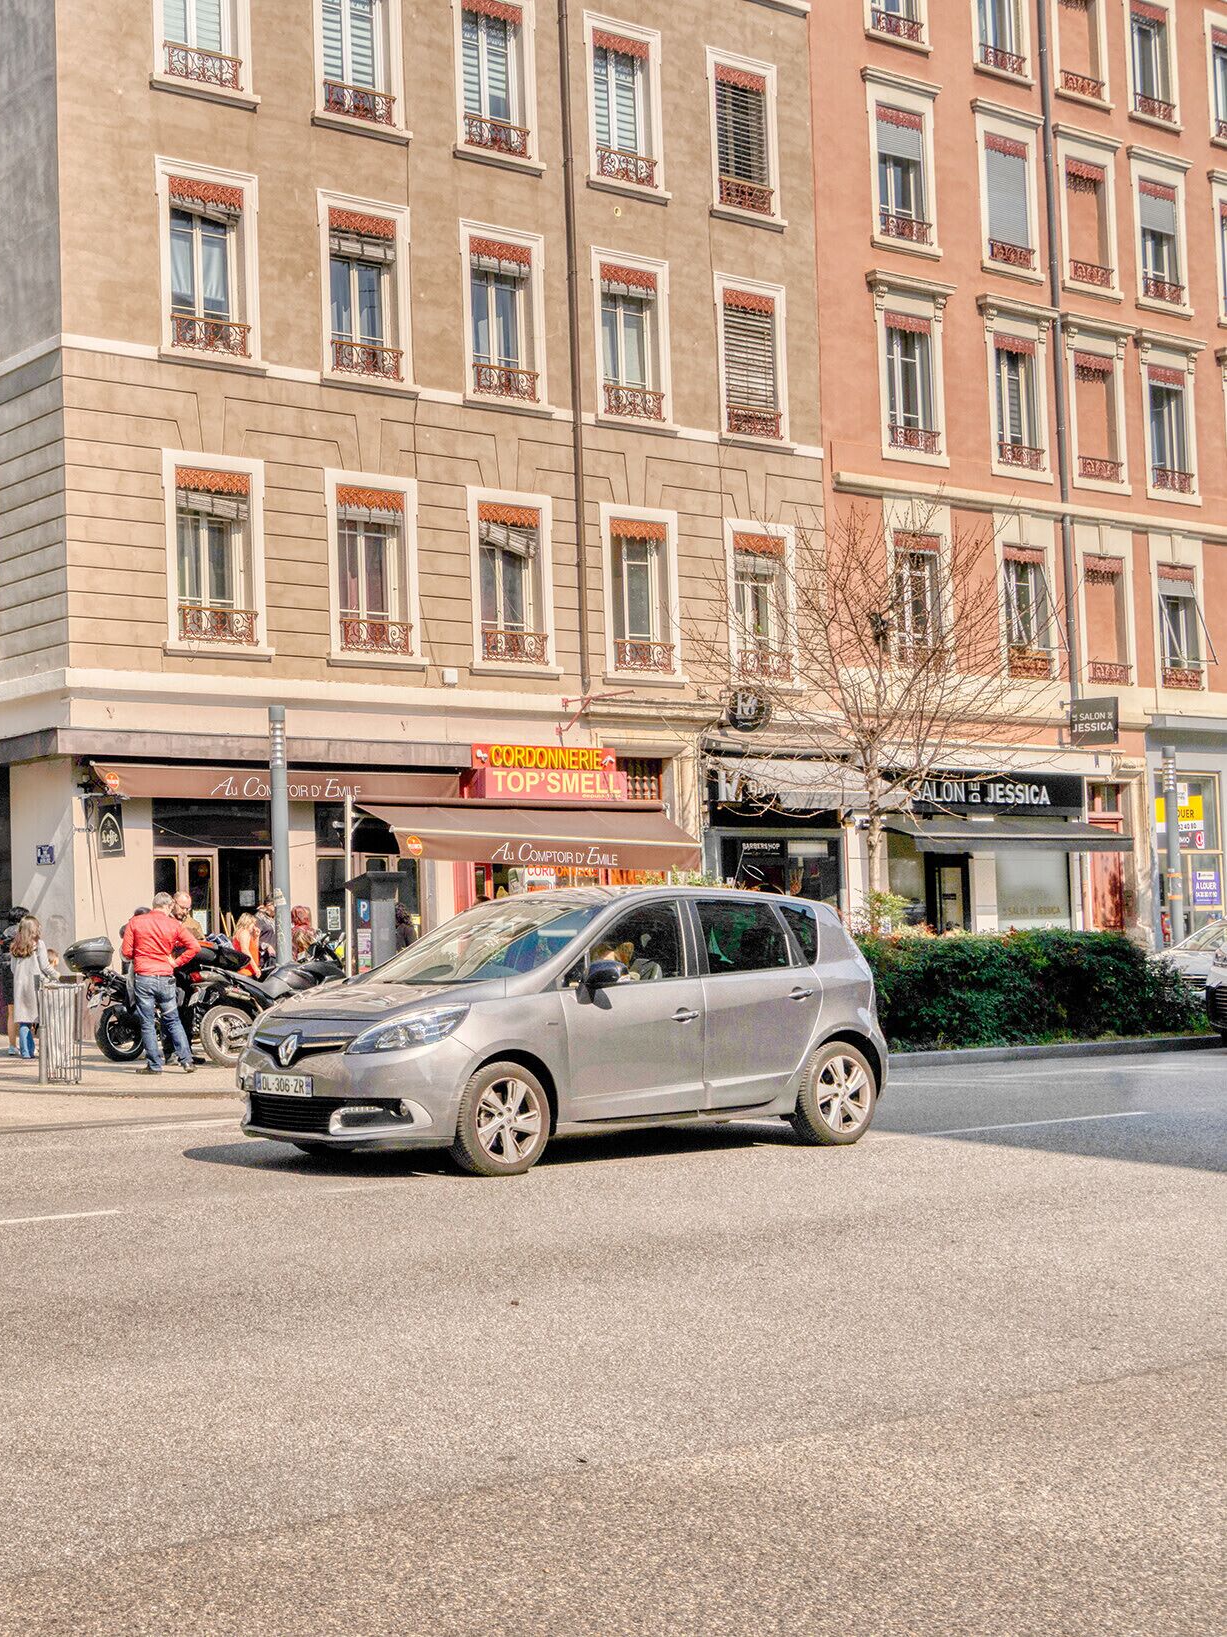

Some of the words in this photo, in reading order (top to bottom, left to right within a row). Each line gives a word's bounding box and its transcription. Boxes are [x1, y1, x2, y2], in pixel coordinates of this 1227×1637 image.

[1072, 722, 1114, 733] JESSICA
[1079, 712, 1106, 721] SALON
[491, 745, 603, 771] CORDONNERIE
[243, 776, 309, 797] COMOIR
[492, 771, 622, 794] TOP'SMELL
[911, 780, 965, 802] SALON
[969, 782, 981, 803] DE
[983, 783, 1051, 805] JESSICA
[518, 843, 573, 863] COMPTOIR
[586, 847, 618, 866] EMILE
